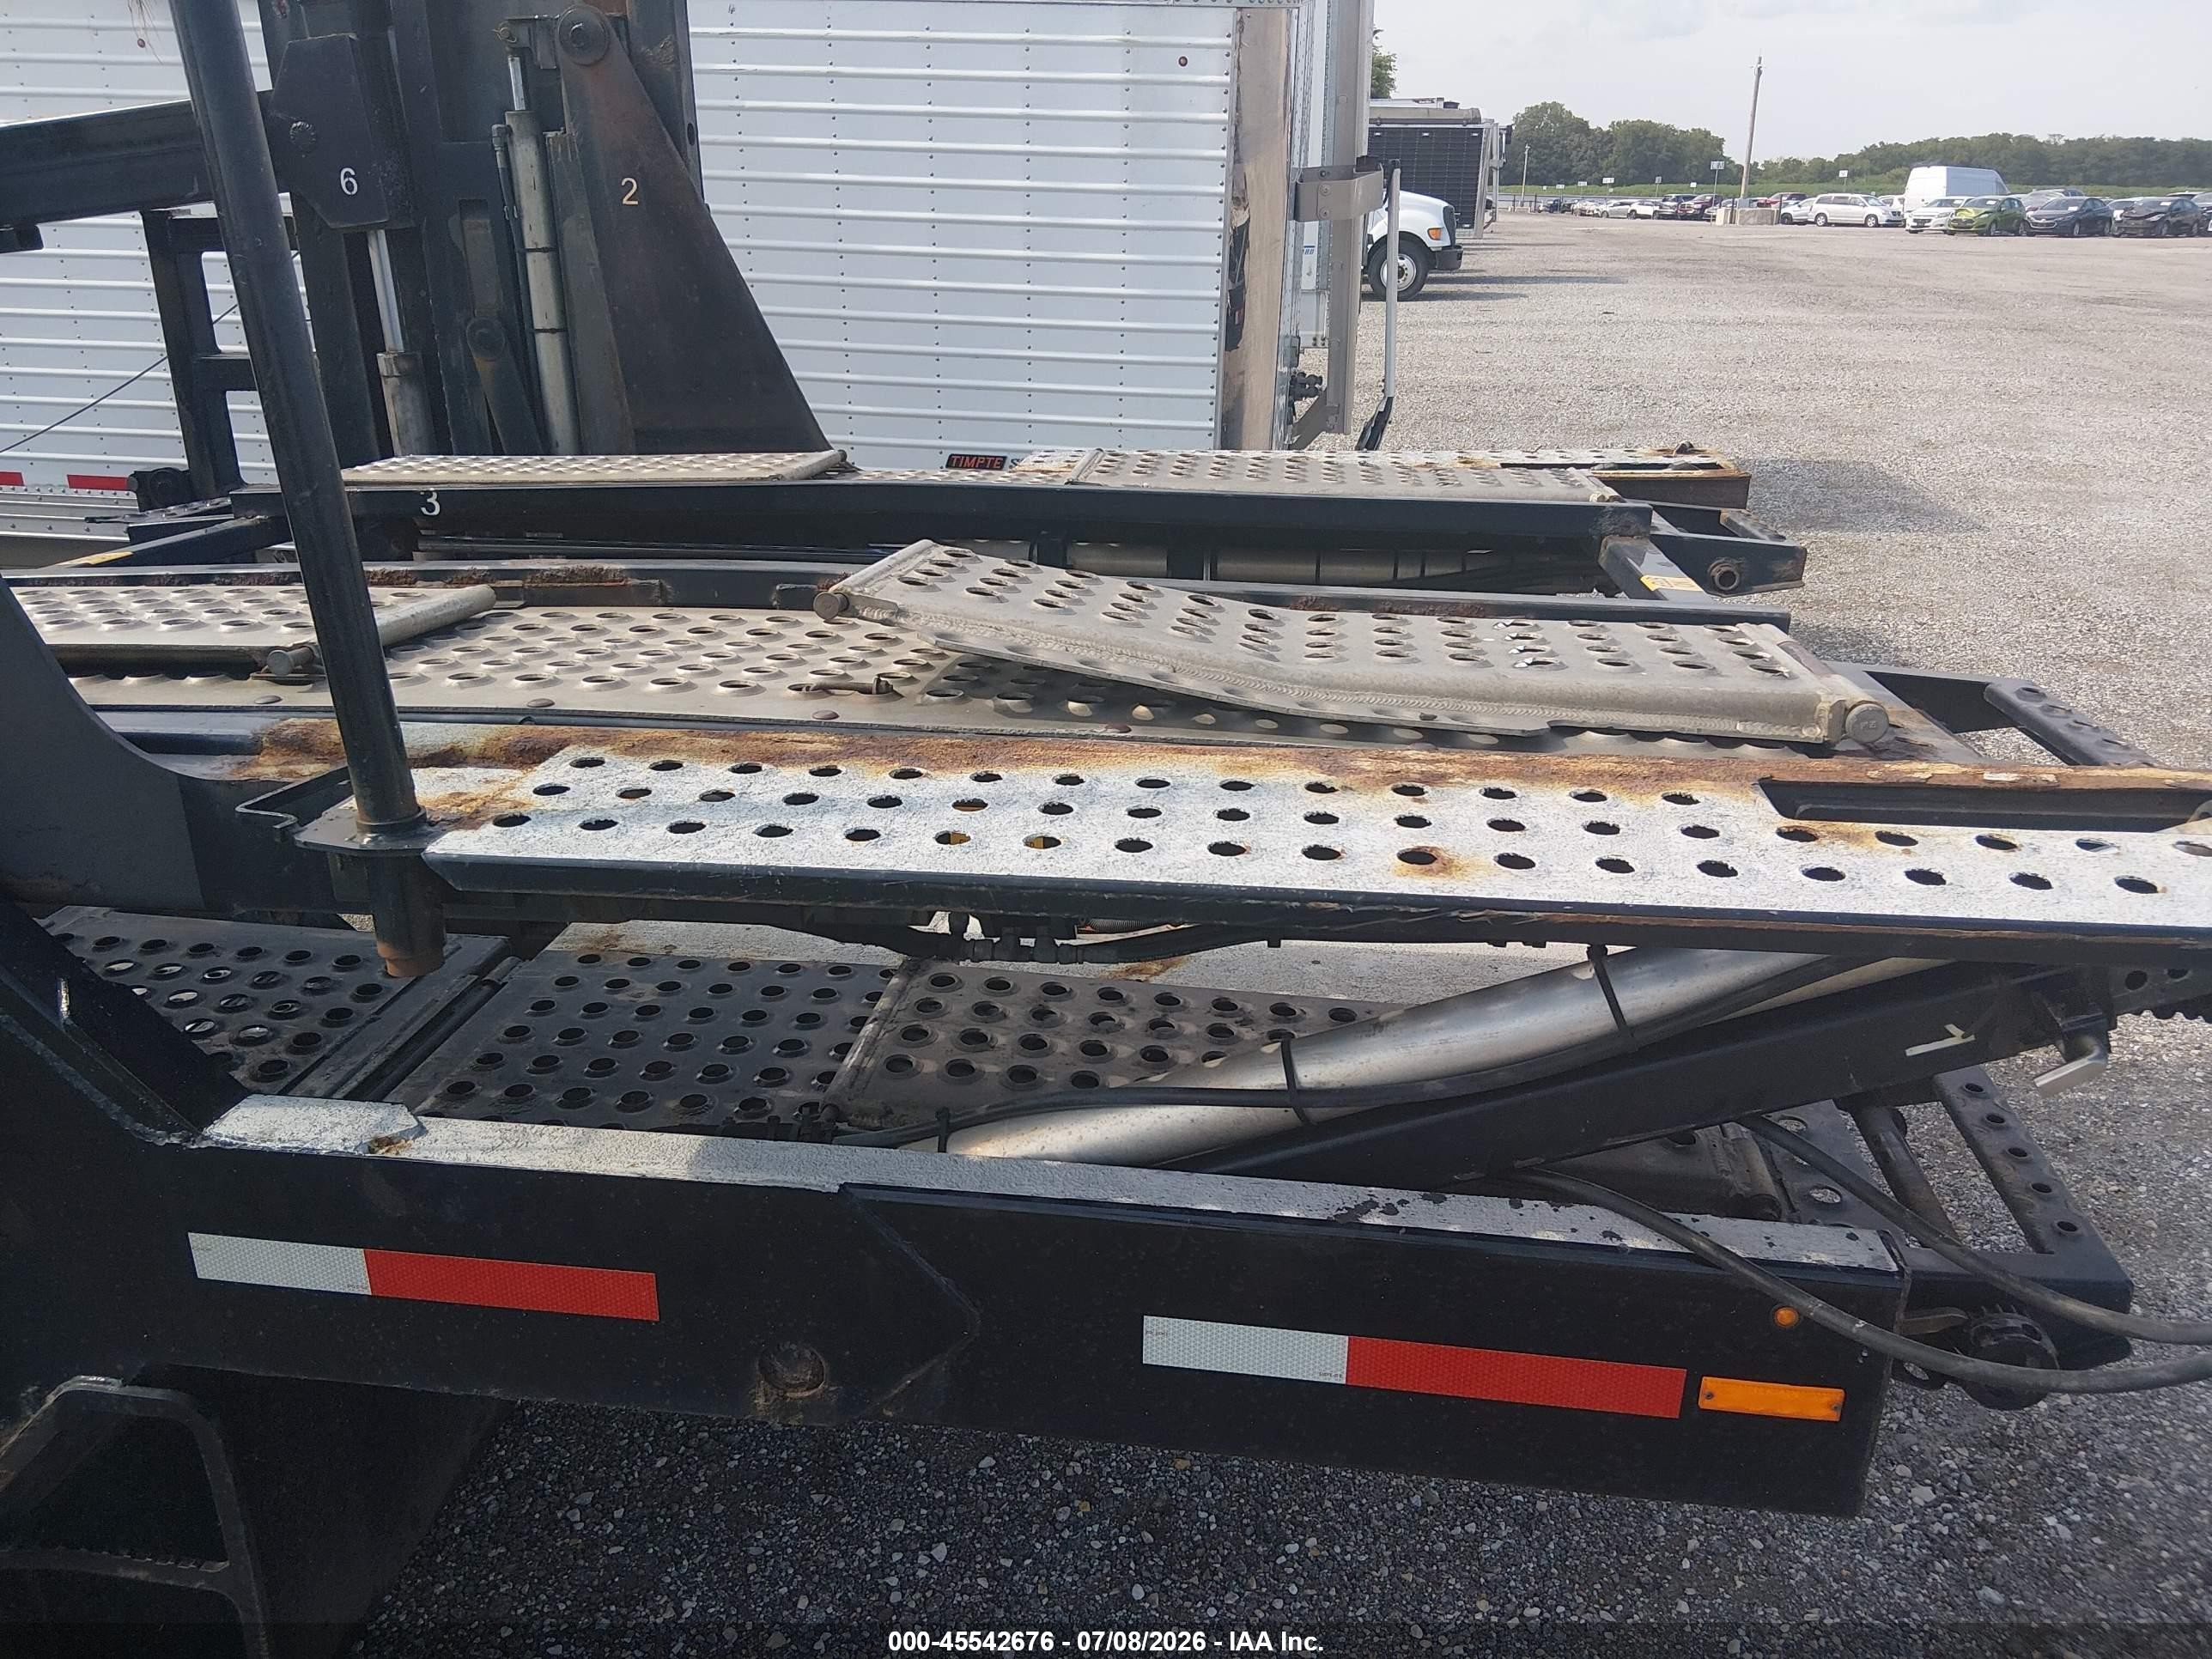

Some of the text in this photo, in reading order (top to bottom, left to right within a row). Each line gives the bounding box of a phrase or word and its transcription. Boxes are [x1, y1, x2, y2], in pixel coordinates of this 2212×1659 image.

[340, 167, 358, 196] 6
[621, 177, 639, 205] 2
[951, 455, 1004, 469] TIMPTE
[420, 490, 441, 516] 3
